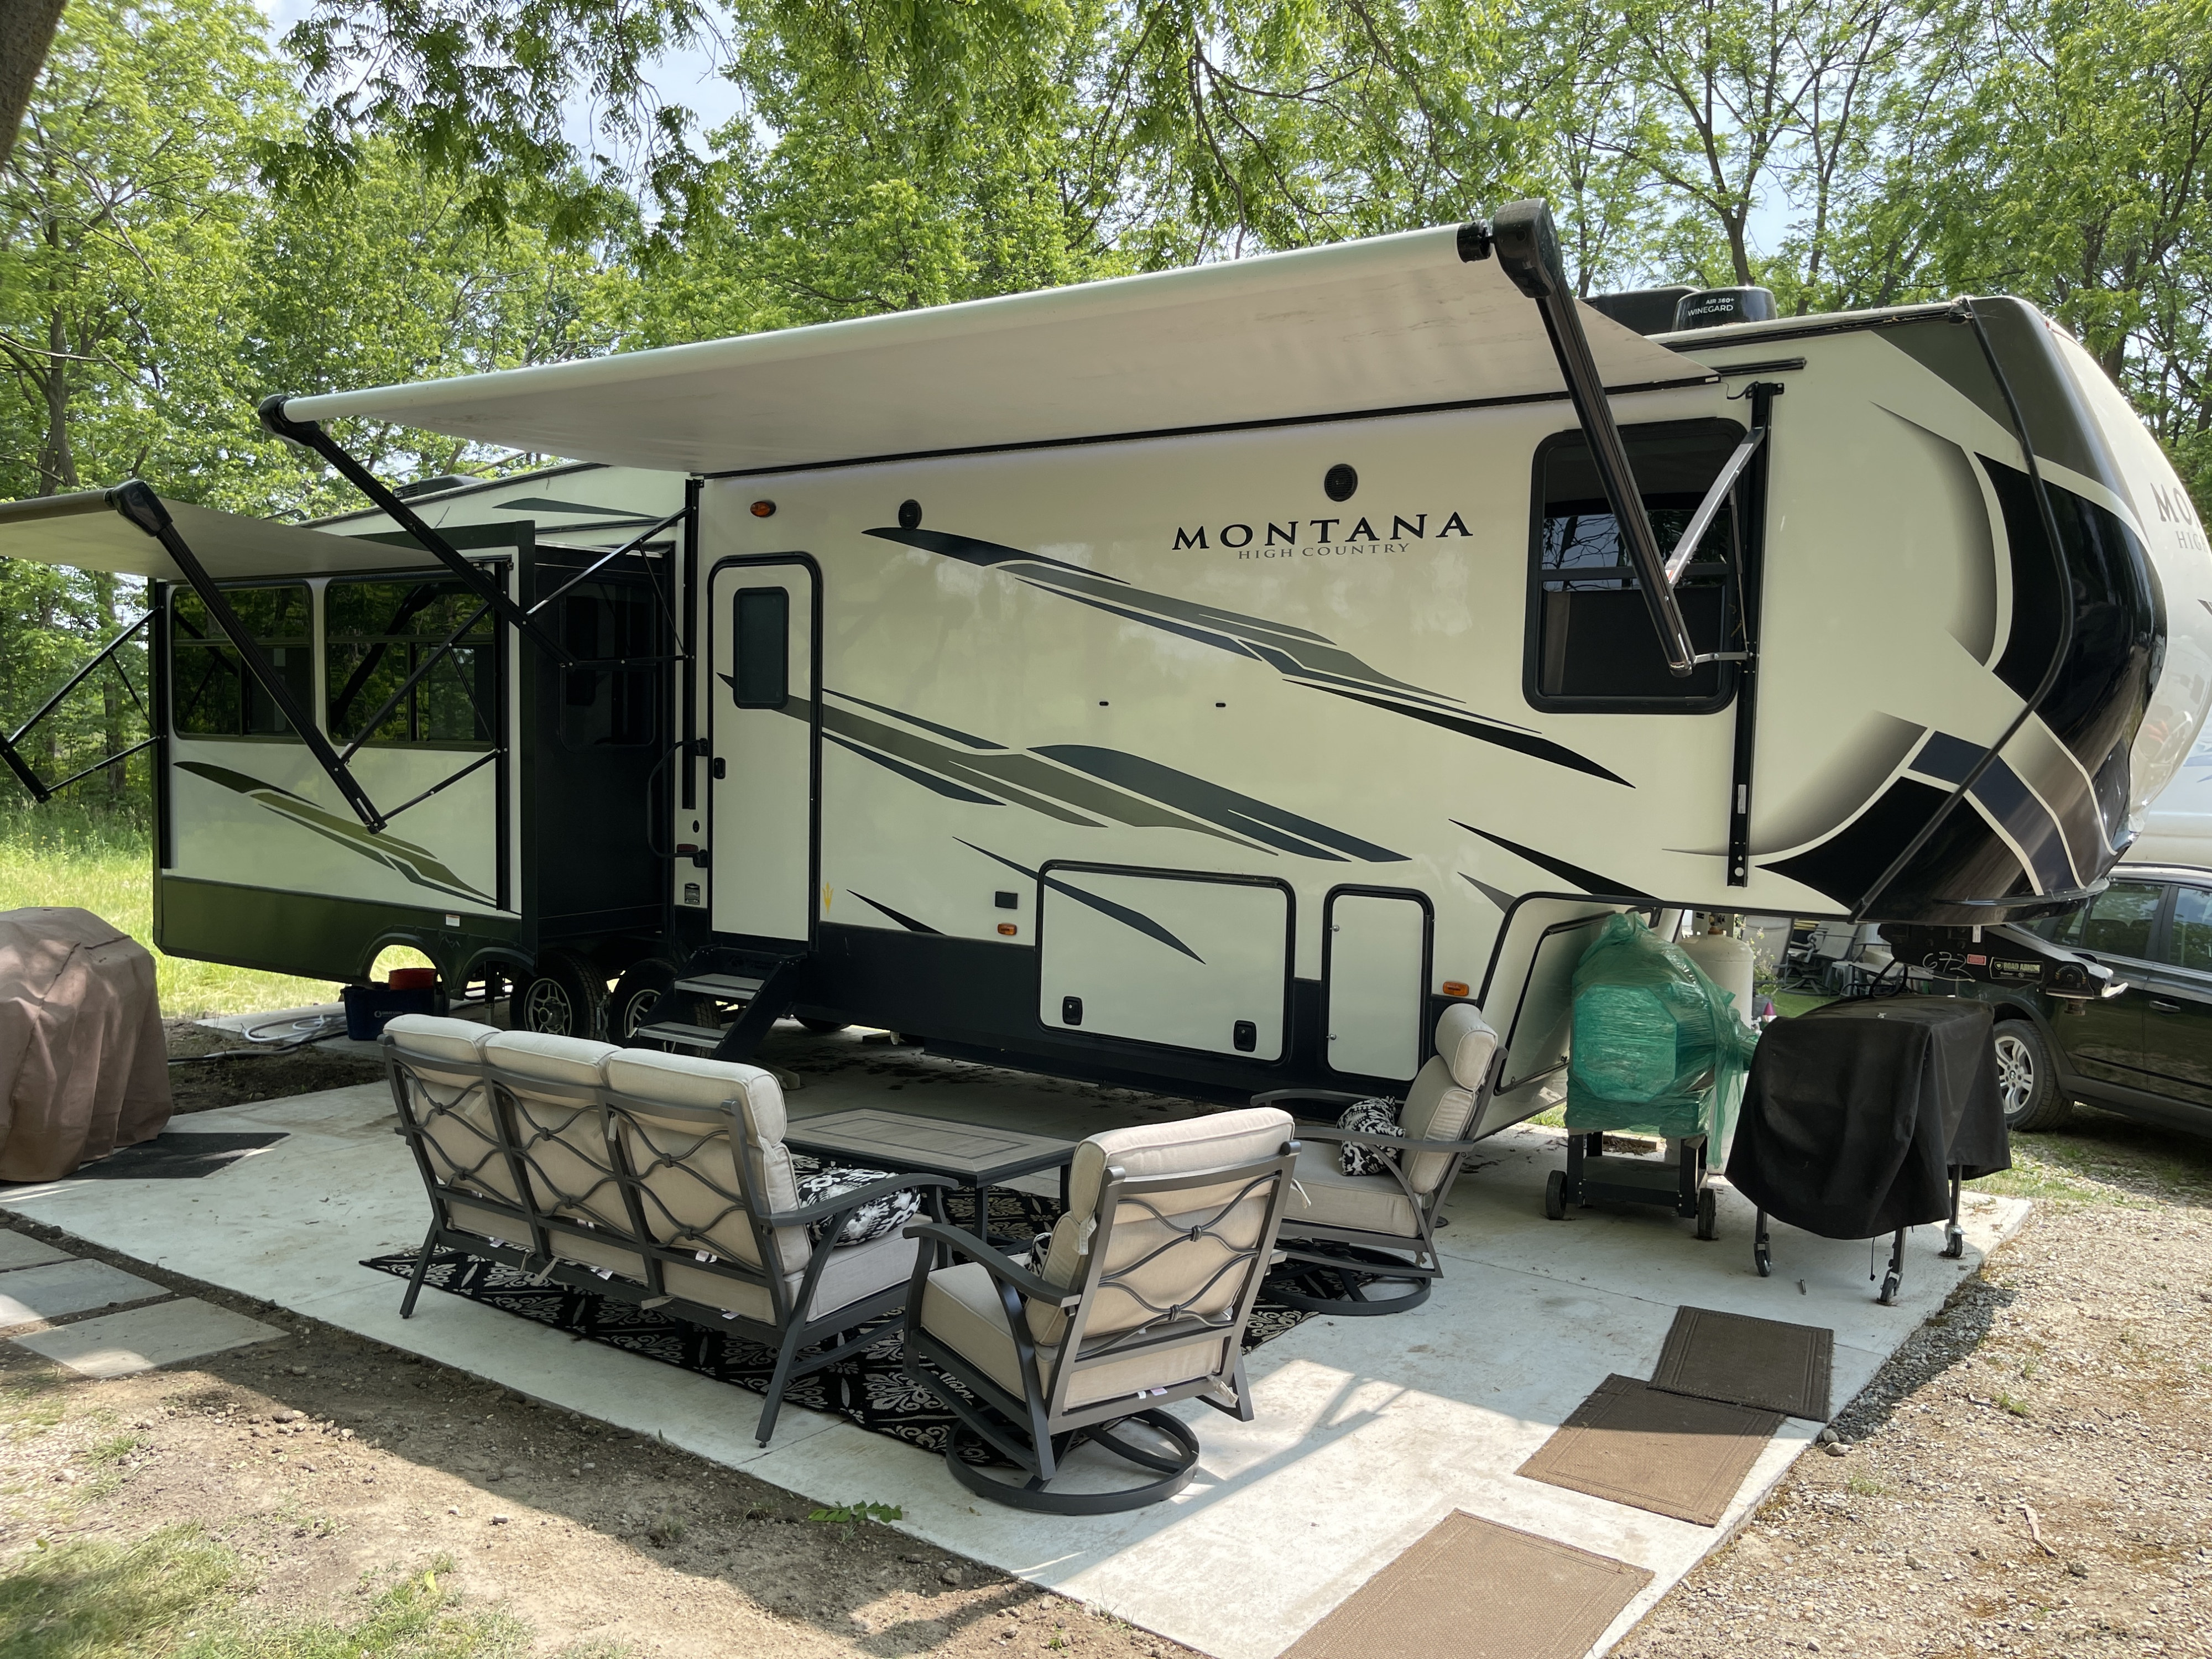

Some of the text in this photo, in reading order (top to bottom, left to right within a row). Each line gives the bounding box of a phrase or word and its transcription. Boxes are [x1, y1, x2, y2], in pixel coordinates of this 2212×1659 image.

[1688, 305, 1734, 316] WINEGARD
[2151, 482, 2200, 528] MO
[1172, 512, 1473, 550] MONTANA
[1238, 543, 1410, 560] HIGH COUNTRY
[2004, 962, 2019, 971] ROAD
